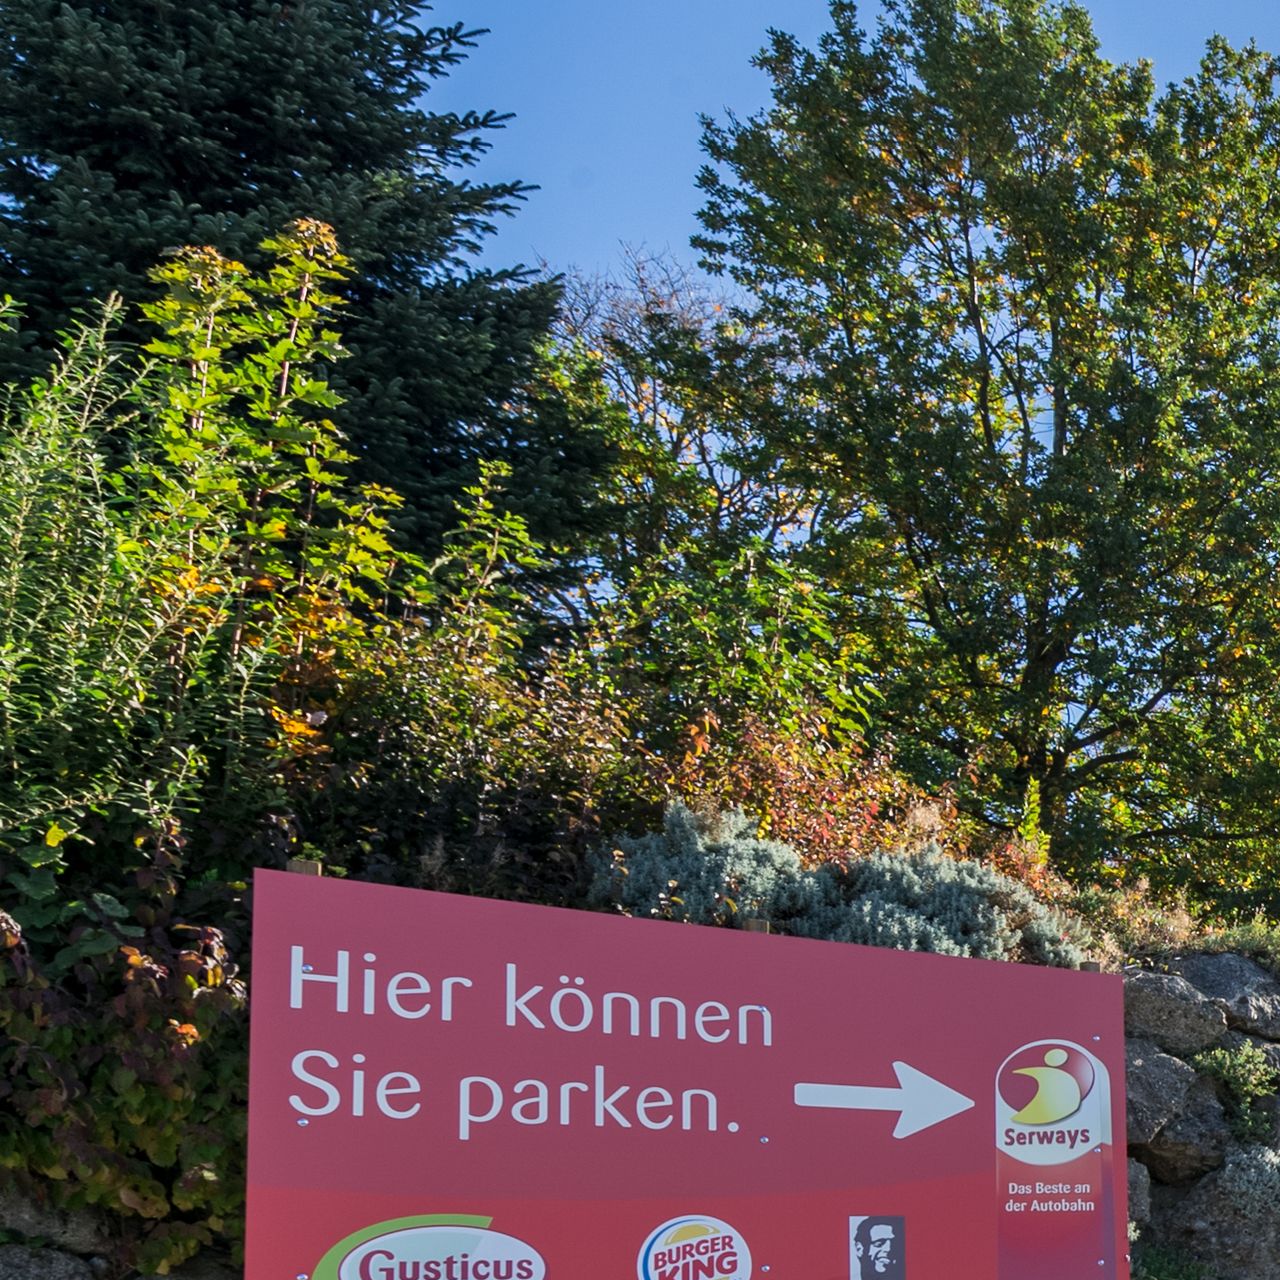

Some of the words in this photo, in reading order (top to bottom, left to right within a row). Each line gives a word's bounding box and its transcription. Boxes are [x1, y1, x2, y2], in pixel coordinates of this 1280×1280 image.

[289, 945, 472, 1021] Hier
[506, 963, 772, 1046] können
[288, 1049, 421, 1119] Sie
[459, 1065, 740, 1140] parken.
[1004, 1128, 1090, 1149] Serways
[1008, 1182, 1032, 1194] Das
[1035, 1182, 1071, 1194] Beste
[1074, 1184, 1090, 1193] an
[1005, 1199, 1027, 1211] der
[1030, 1198, 1095, 1211] Autobahn
[654, 1235, 734, 1271] BURGER
